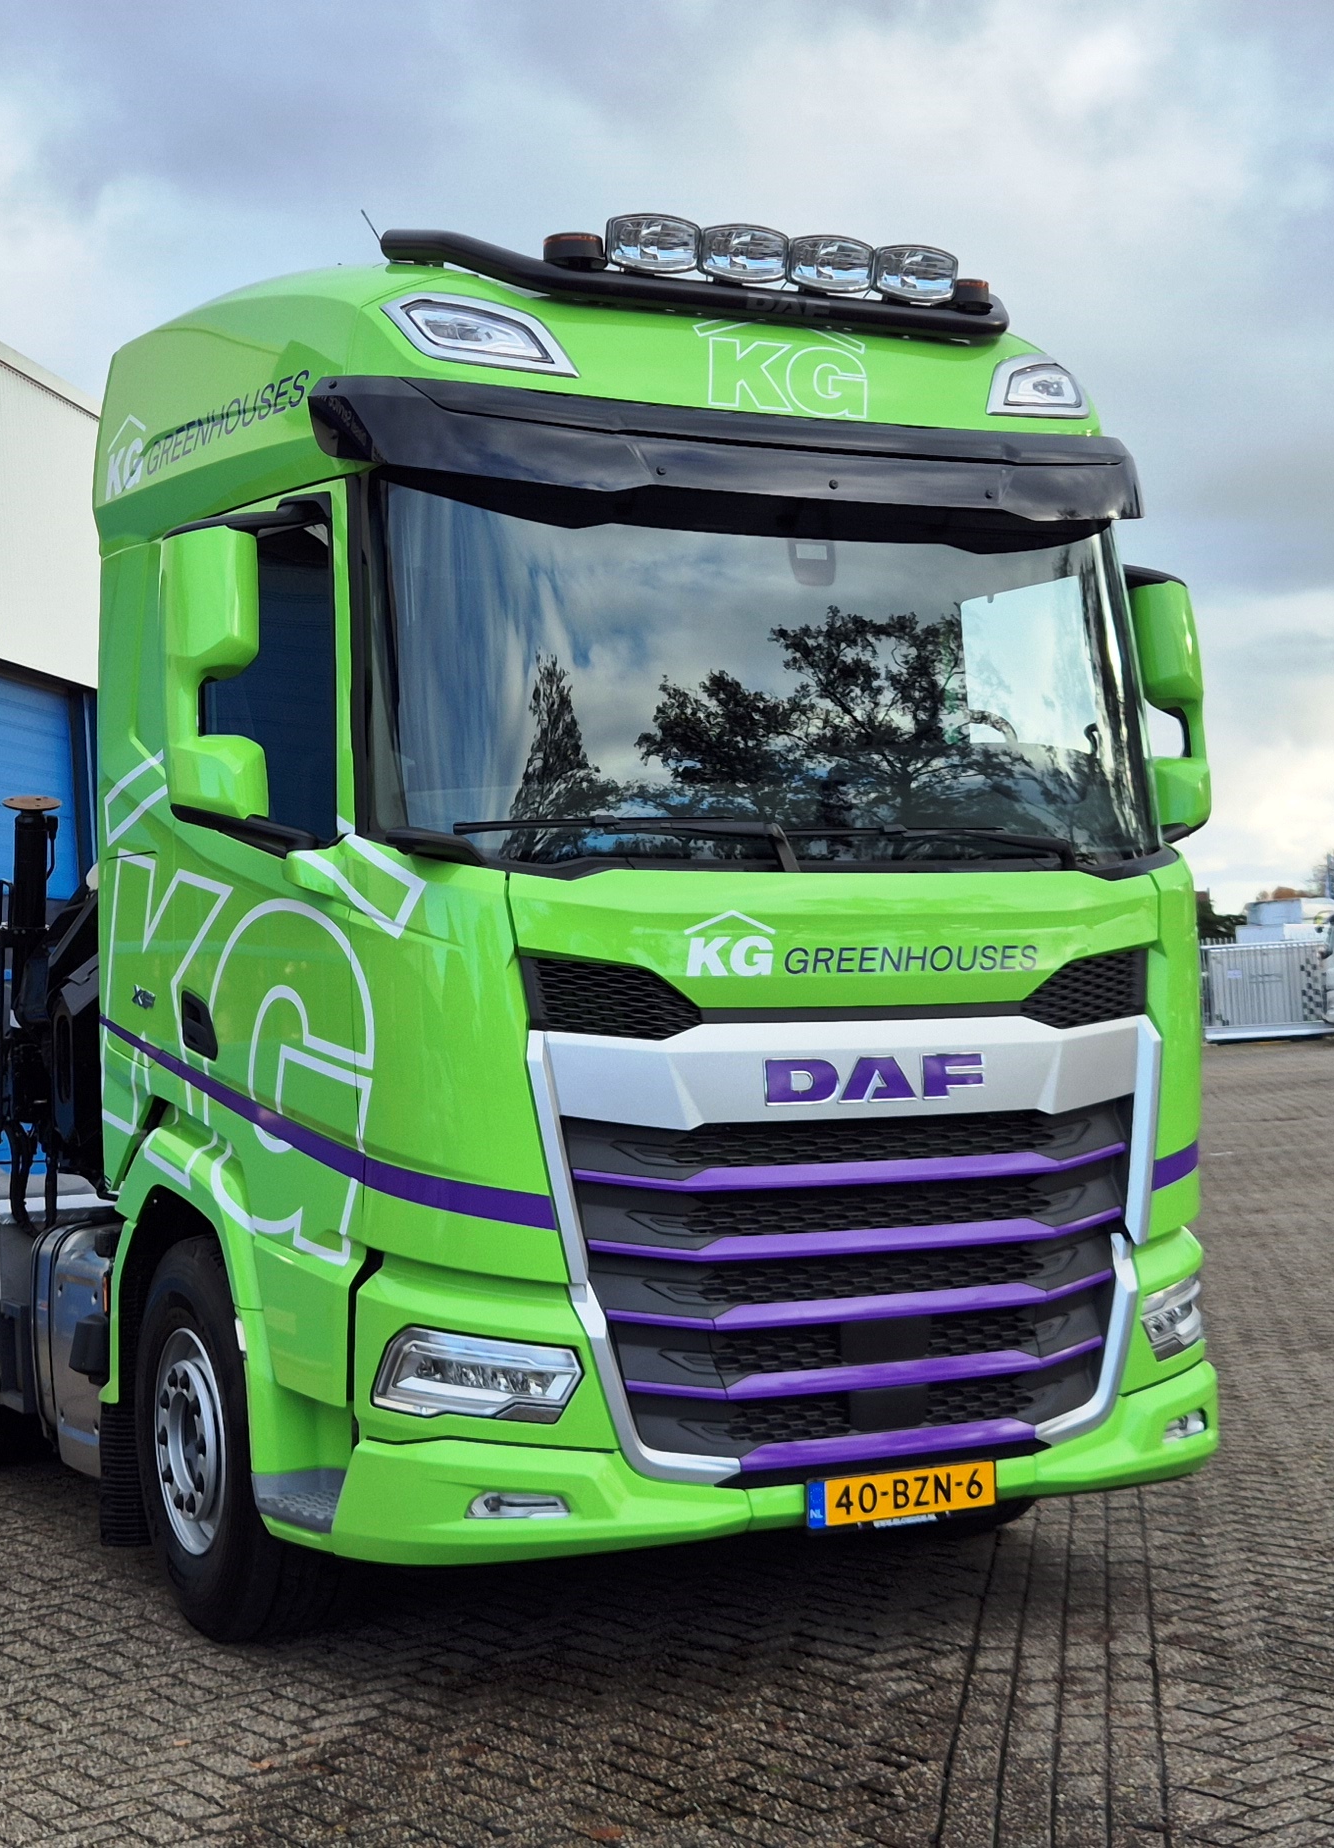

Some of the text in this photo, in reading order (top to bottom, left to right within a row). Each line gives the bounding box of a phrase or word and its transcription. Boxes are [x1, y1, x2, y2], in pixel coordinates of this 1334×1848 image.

[745, 291, 831, 316] DAF
[707, 336, 868, 420] KG
[105, 369, 310, 501] KG GREENHOUSES
[686, 935, 1039, 977] KG GREENHOUSES
[763, 1051, 985, 1107] DAF
[809, 1468, 984, 1519] NL 40-BZN-6
